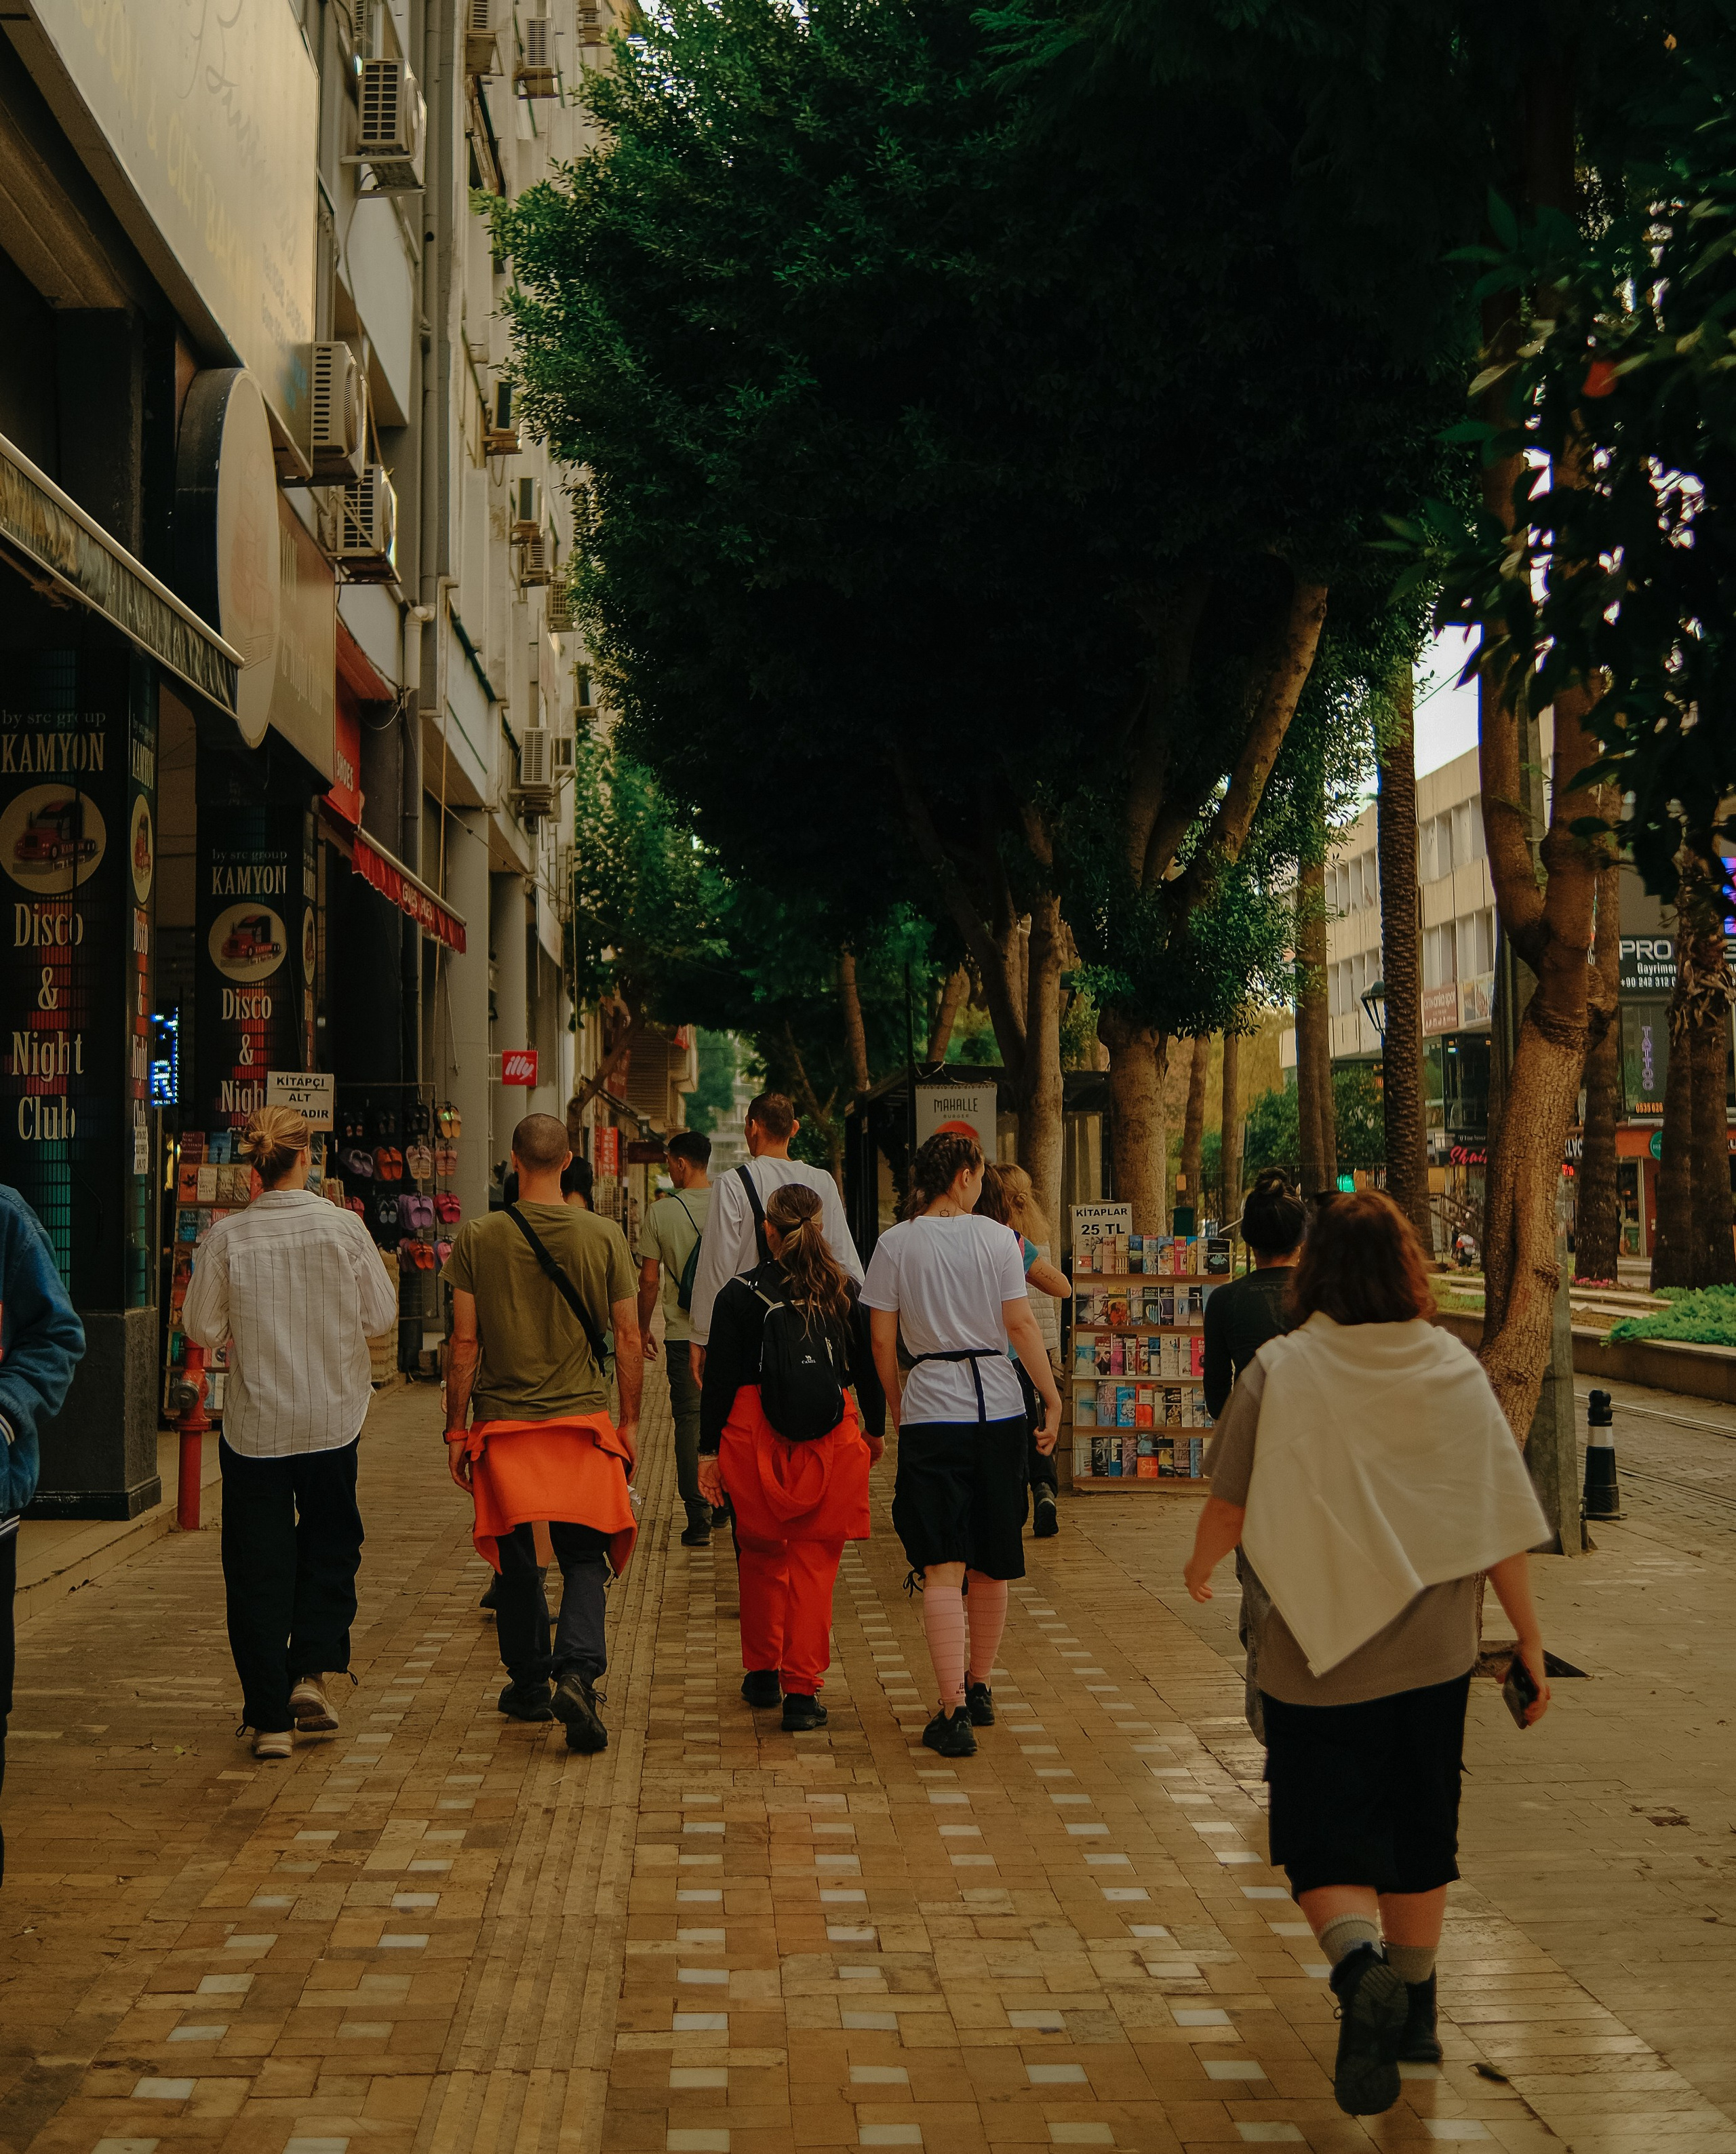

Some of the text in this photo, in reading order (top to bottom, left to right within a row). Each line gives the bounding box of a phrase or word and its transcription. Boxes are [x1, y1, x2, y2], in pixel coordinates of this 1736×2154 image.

[2, 709, 22, 728] by
[26, 714, 52, 724] src
[1, 732, 106, 772] KAMYON
[212, 848, 288, 863] by src group
[212, 865, 287, 895] KAMYON
[14, 903, 83, 947] Disco
[133, 907, 148, 955] Disco
[37, 966, 59, 1010] &
[221, 988, 272, 1019] Disco
[12, 1031, 83, 1082] Night
[132, 1034, 147, 1085] Night
[239, 1034, 254, 1065] &
[1641, 1025, 1653, 1091] TATTOO
[277, 1076, 324, 1089] KİTAPÇI
[505, 1055, 534, 1080] illy
[220, 1080, 265, 1118] Nigh
[289, 1093, 311, 1102] ALT
[934, 1098, 978, 1113] MAHALLE
[18, 1096, 76, 1141] Club
[1076, 1208, 1128, 1217] KİTAPLAR
[1081, 1223, 1125, 1234] 25 TL
